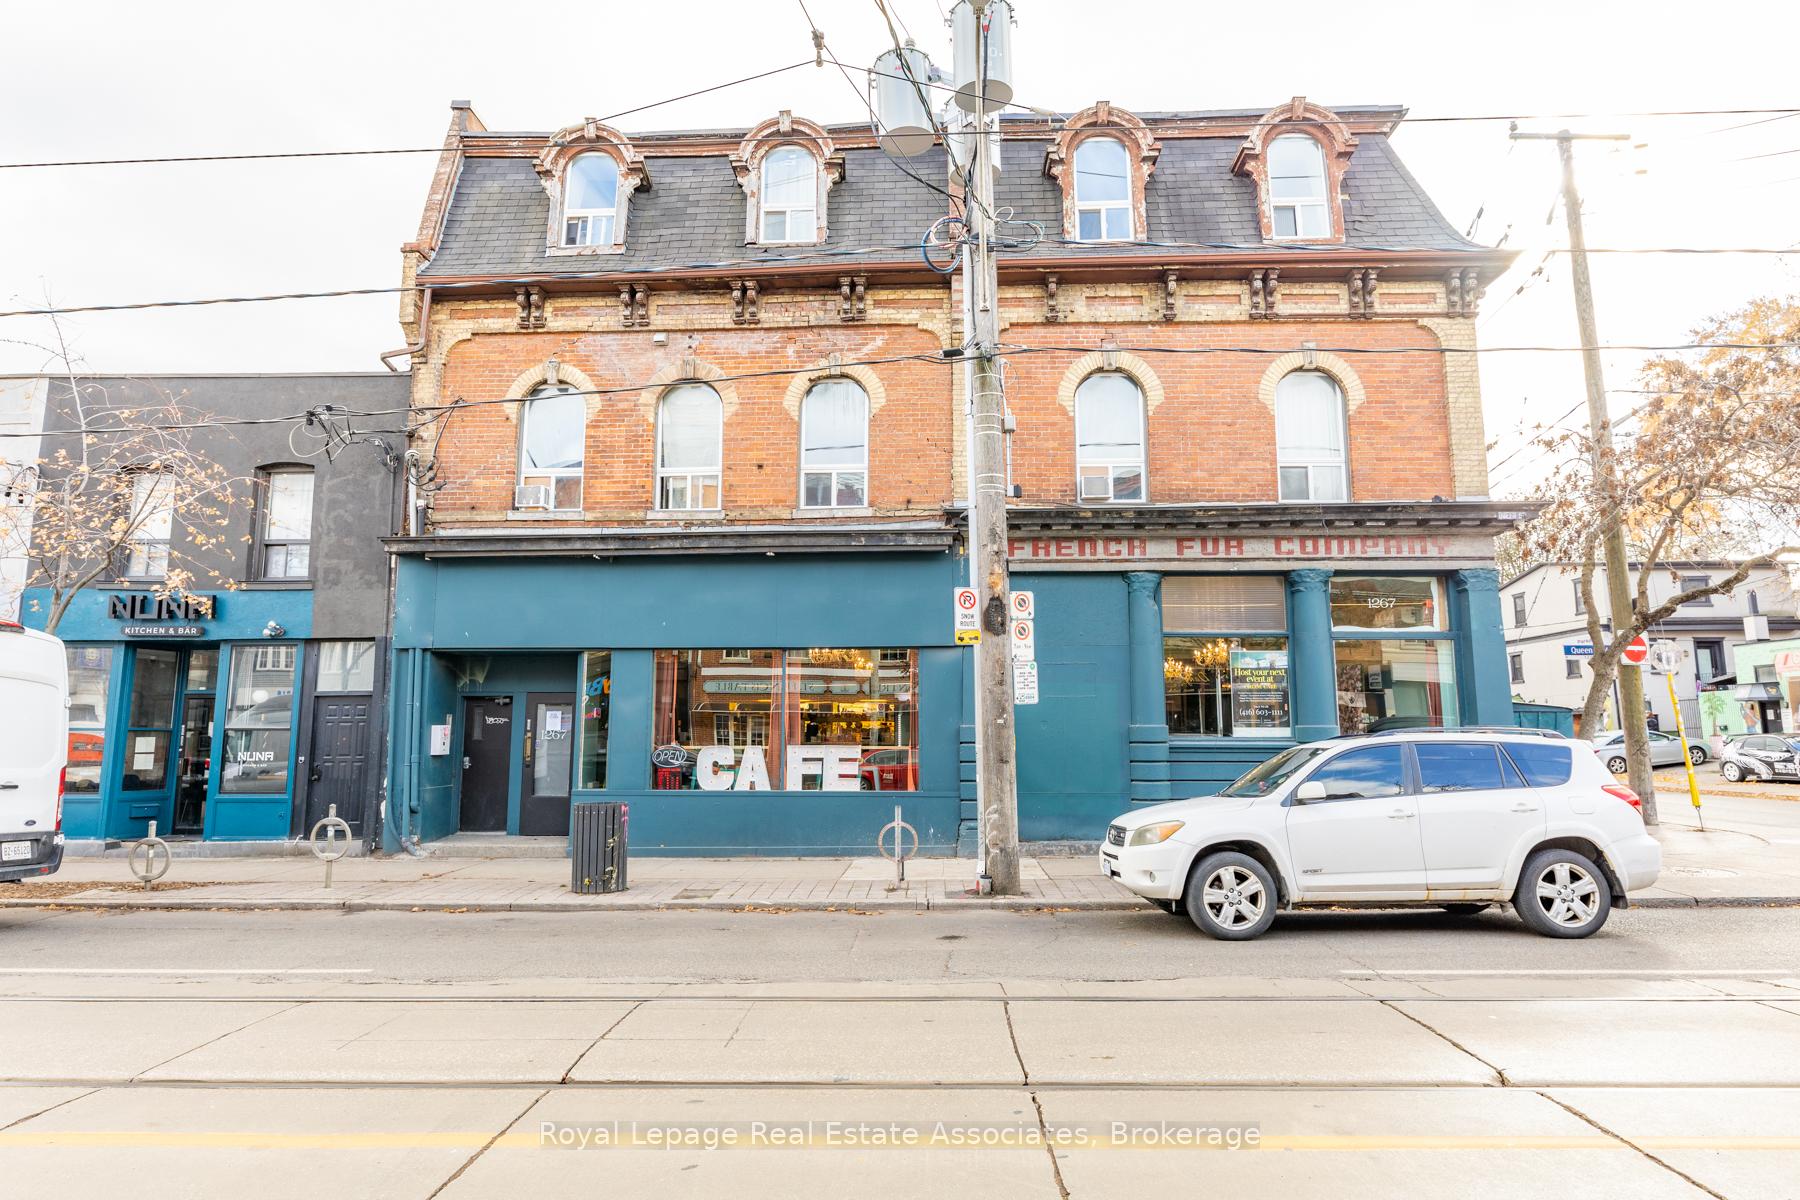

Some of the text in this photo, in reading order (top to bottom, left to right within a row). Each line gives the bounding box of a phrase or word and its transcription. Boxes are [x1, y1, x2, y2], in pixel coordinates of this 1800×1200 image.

[1008, 535, 1449, 557] FRENCH FUR COMPANY
[1367, 598, 1396, 609] 1267
[1570, 646, 1593, 655] Queen
[1253, 669, 1268, 677] your
[1239, 708, 1255, 716] (416)
[541, 730, 567, 740] 1267
[238, 752, 274, 761] NUNA
[654, 750, 685, 762] OPEN
